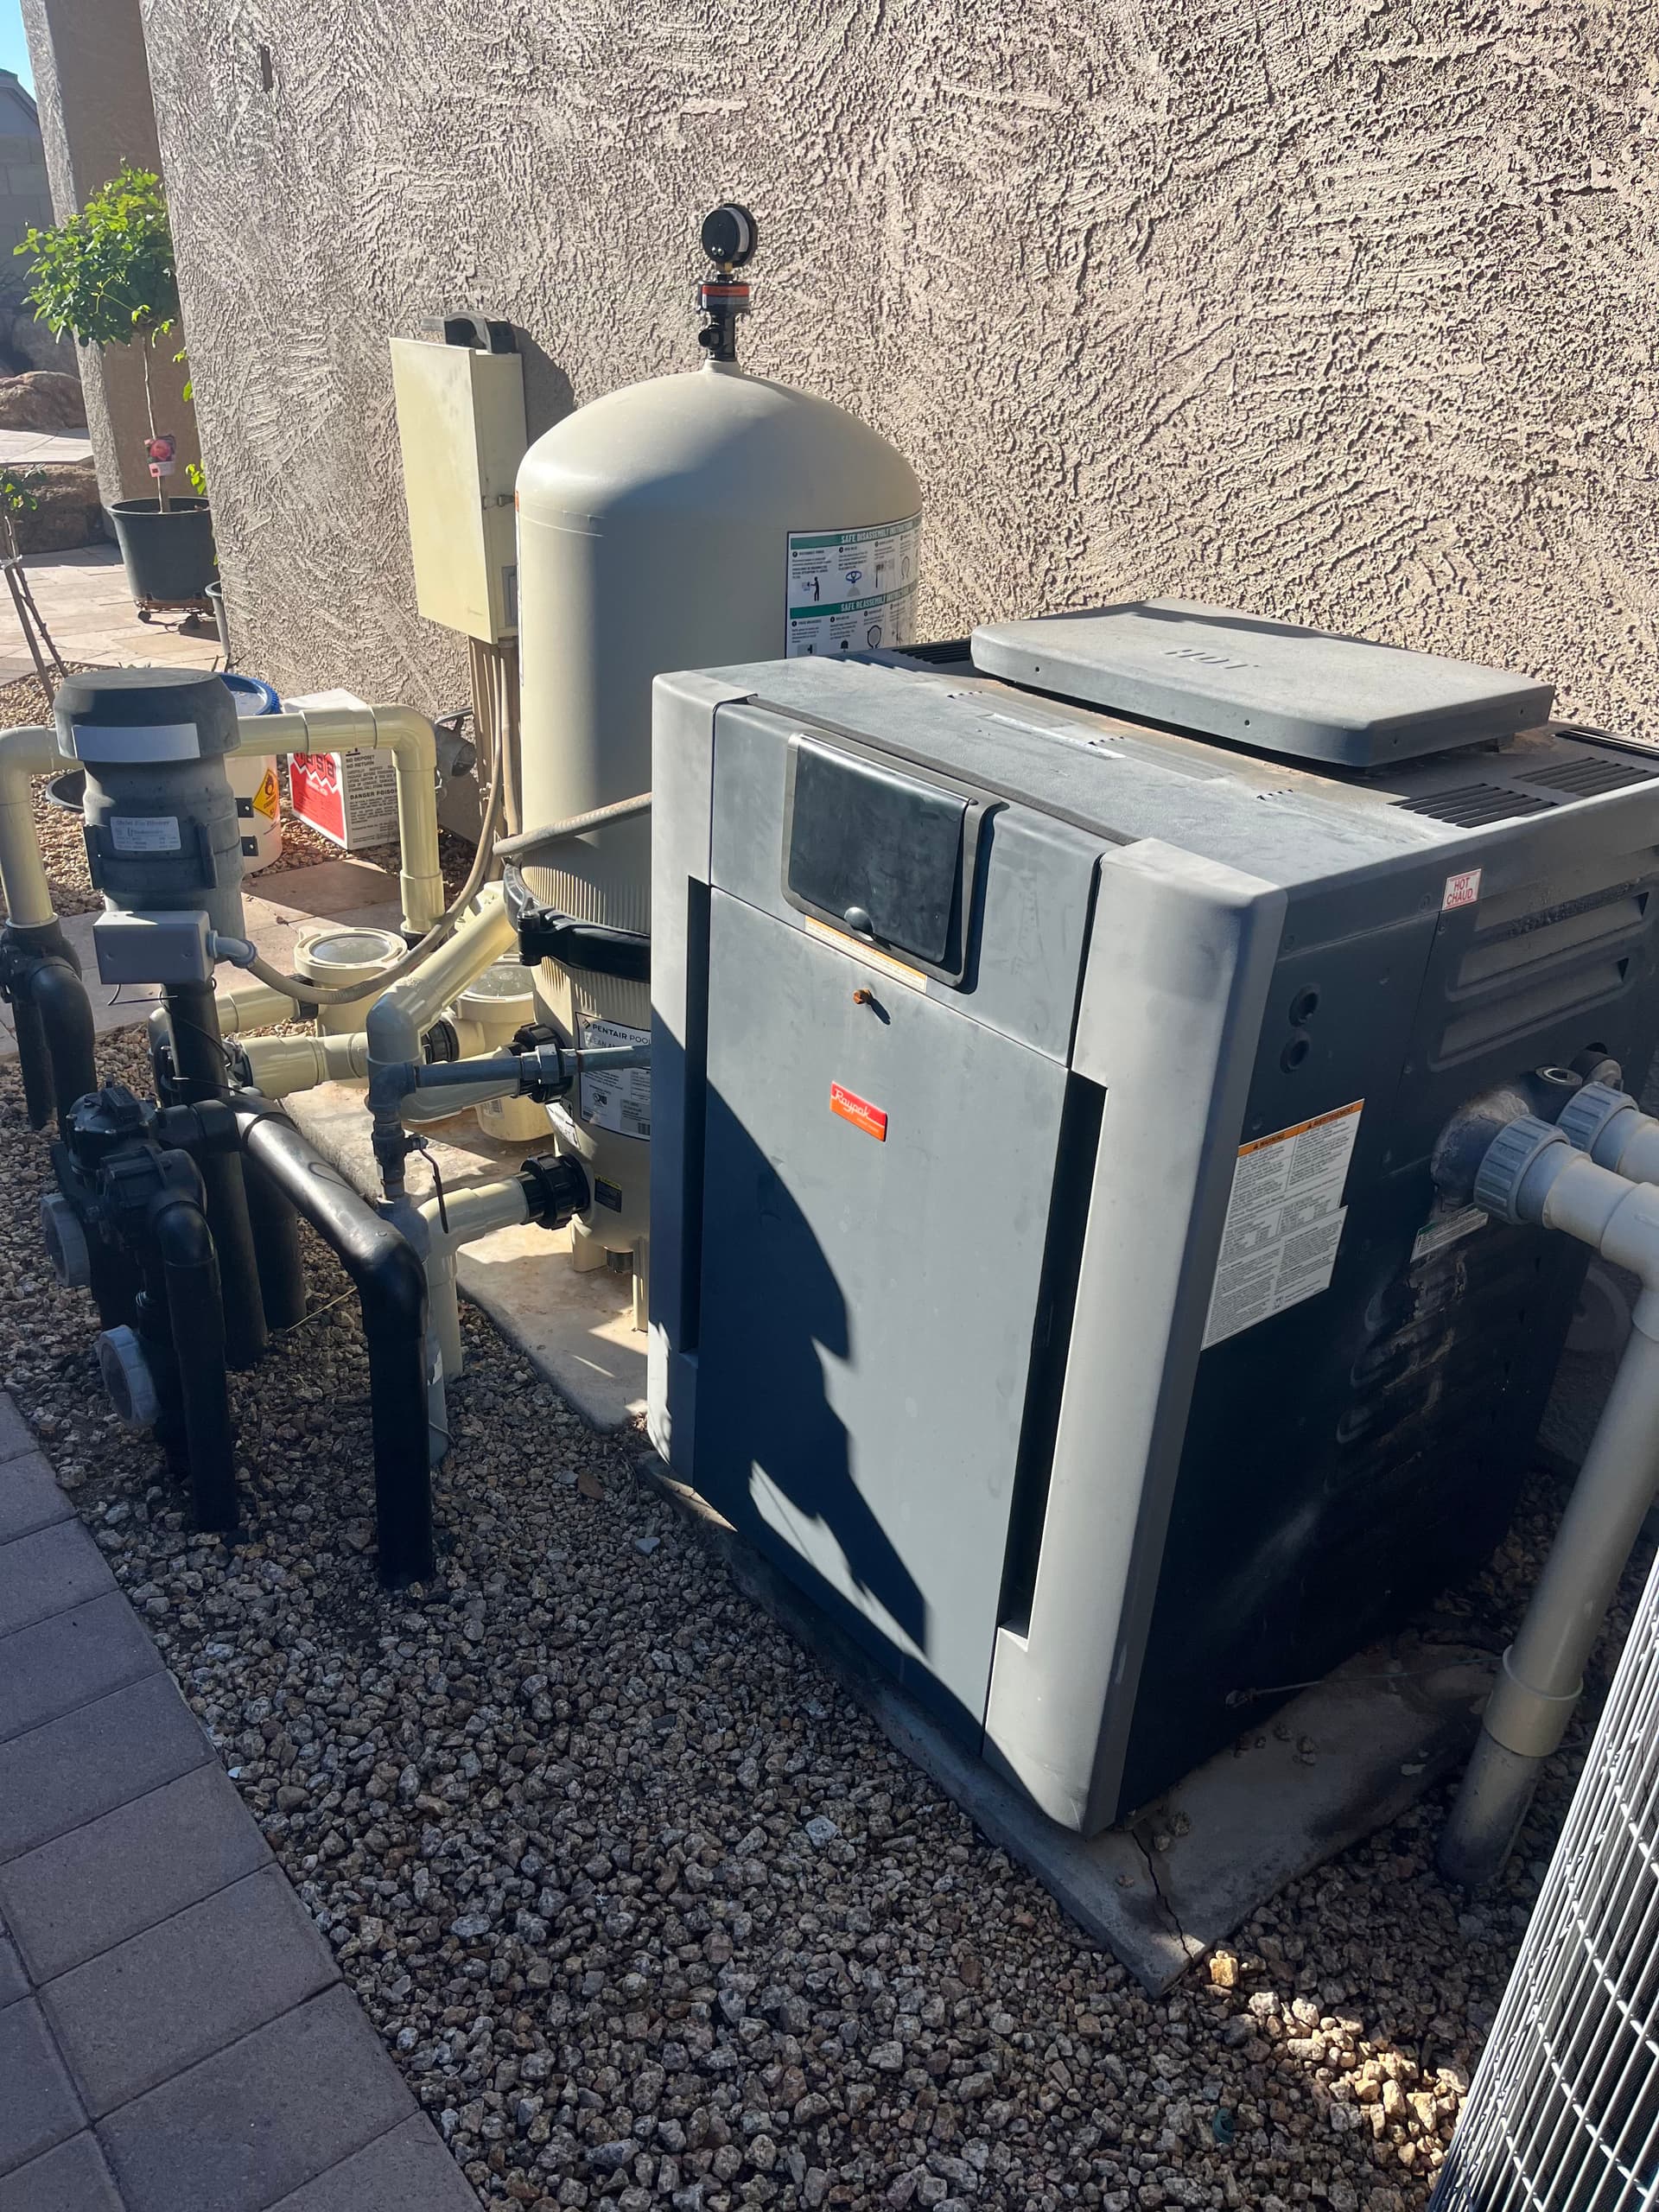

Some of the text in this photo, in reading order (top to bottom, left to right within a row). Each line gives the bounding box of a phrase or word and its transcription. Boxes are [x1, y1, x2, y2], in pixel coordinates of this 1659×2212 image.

[841, 533, 855, 543] SAFE
[841, 602, 855, 612] SAFE
[1161, 648, 1261, 670] HOT
[350, 791, 375, 800] DANGER
[1454, 877, 1471, 890] HOT
[1446, 888, 1473, 905] CHAUD
[592, 1024, 628, 1040] PENTAIR
[831, 1088, 871, 1118] Raypak
